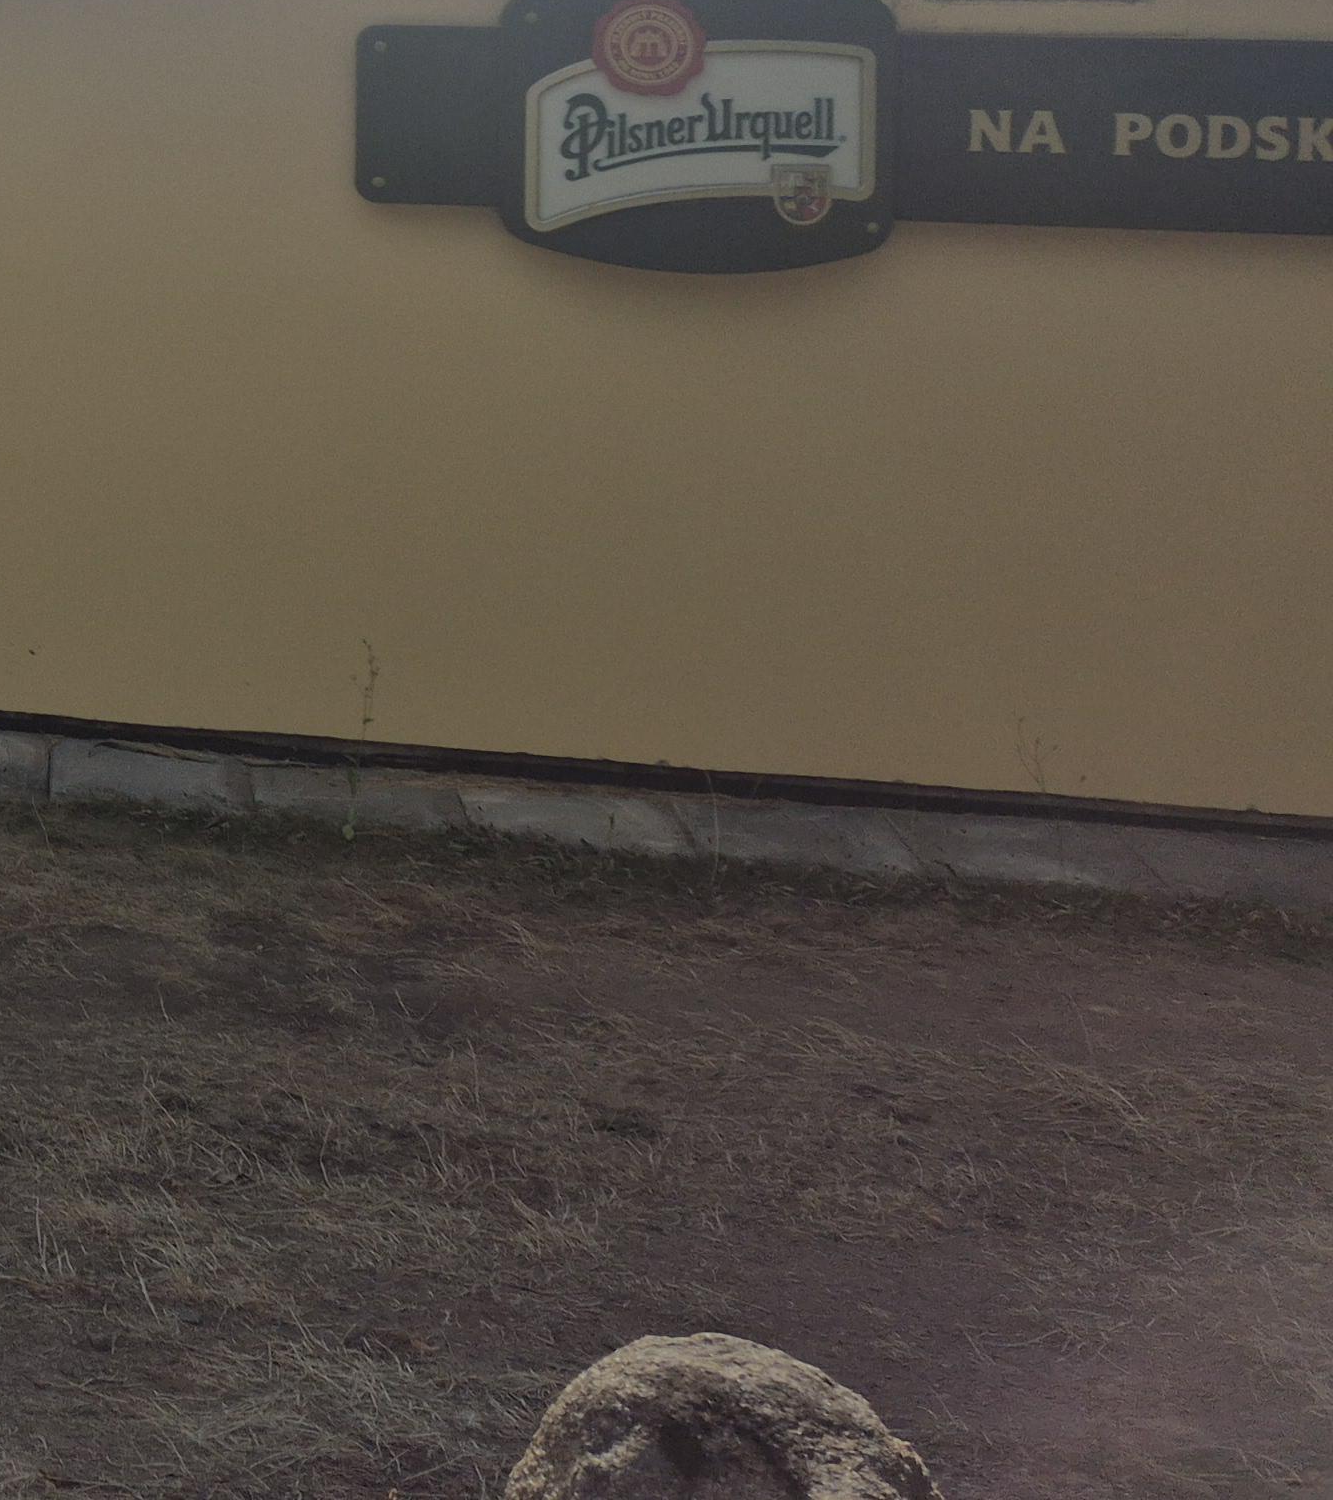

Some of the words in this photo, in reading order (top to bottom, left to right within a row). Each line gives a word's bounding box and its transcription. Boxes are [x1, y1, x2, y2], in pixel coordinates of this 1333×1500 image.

[561, 92, 704, 181] Pilsner
[701, 92, 834, 161] Urquell
[967, 108, 1067, 154] NA
[1112, 111, 1333, 163] PODSK
